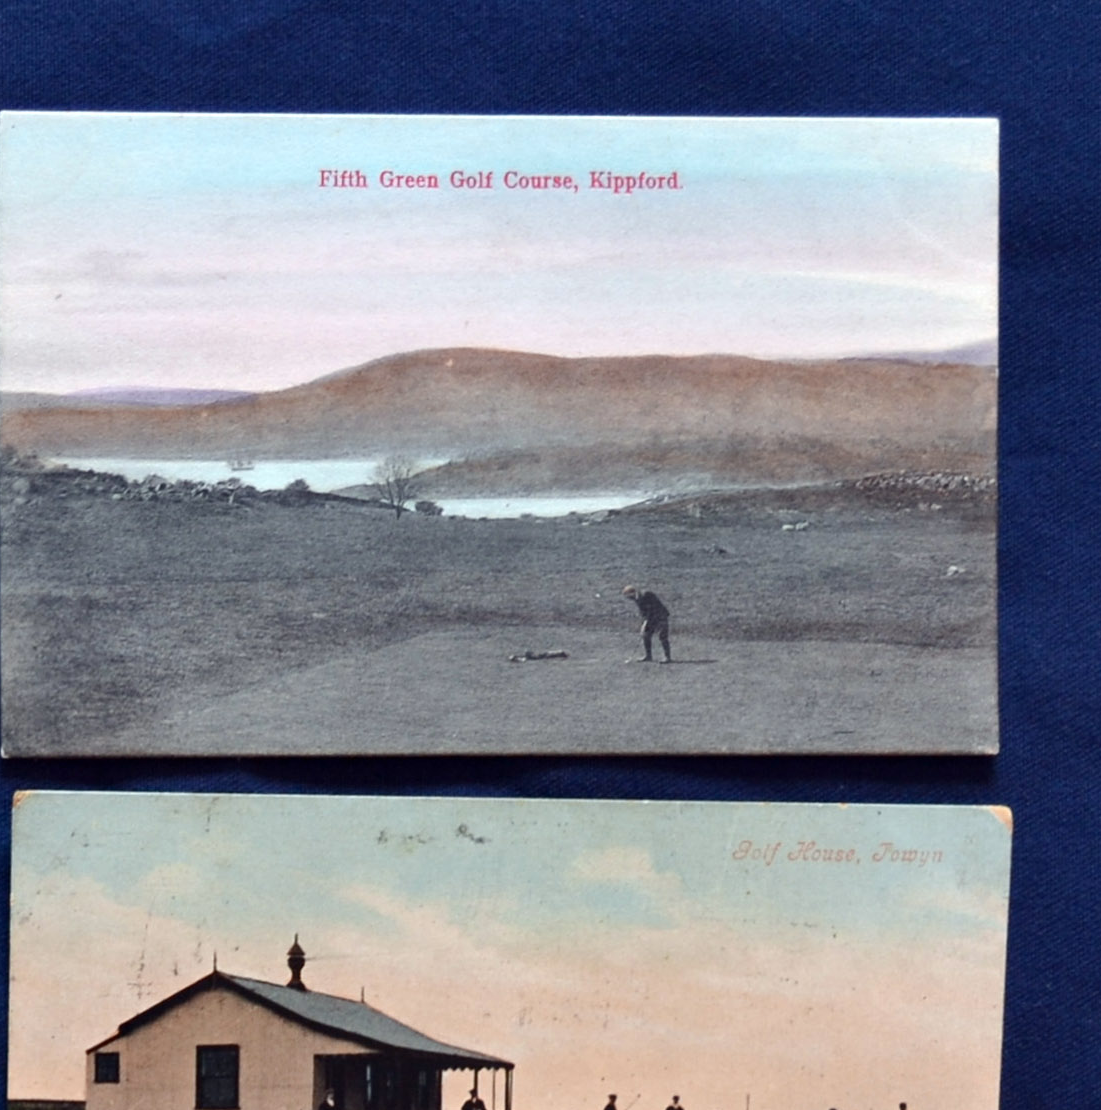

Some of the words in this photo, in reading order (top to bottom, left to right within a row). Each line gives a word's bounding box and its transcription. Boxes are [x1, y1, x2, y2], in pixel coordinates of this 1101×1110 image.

[319, 169, 368, 188] Fifth
[379, 170, 439, 189] Green
[450, 170, 494, 189] Golf
[503, 170, 579, 192] Course,
[589, 170, 684, 194] Kippford.
[731, 840, 782, 866] Golf
[787, 840, 861, 865] House,
[872, 842, 944, 867] Towyn
